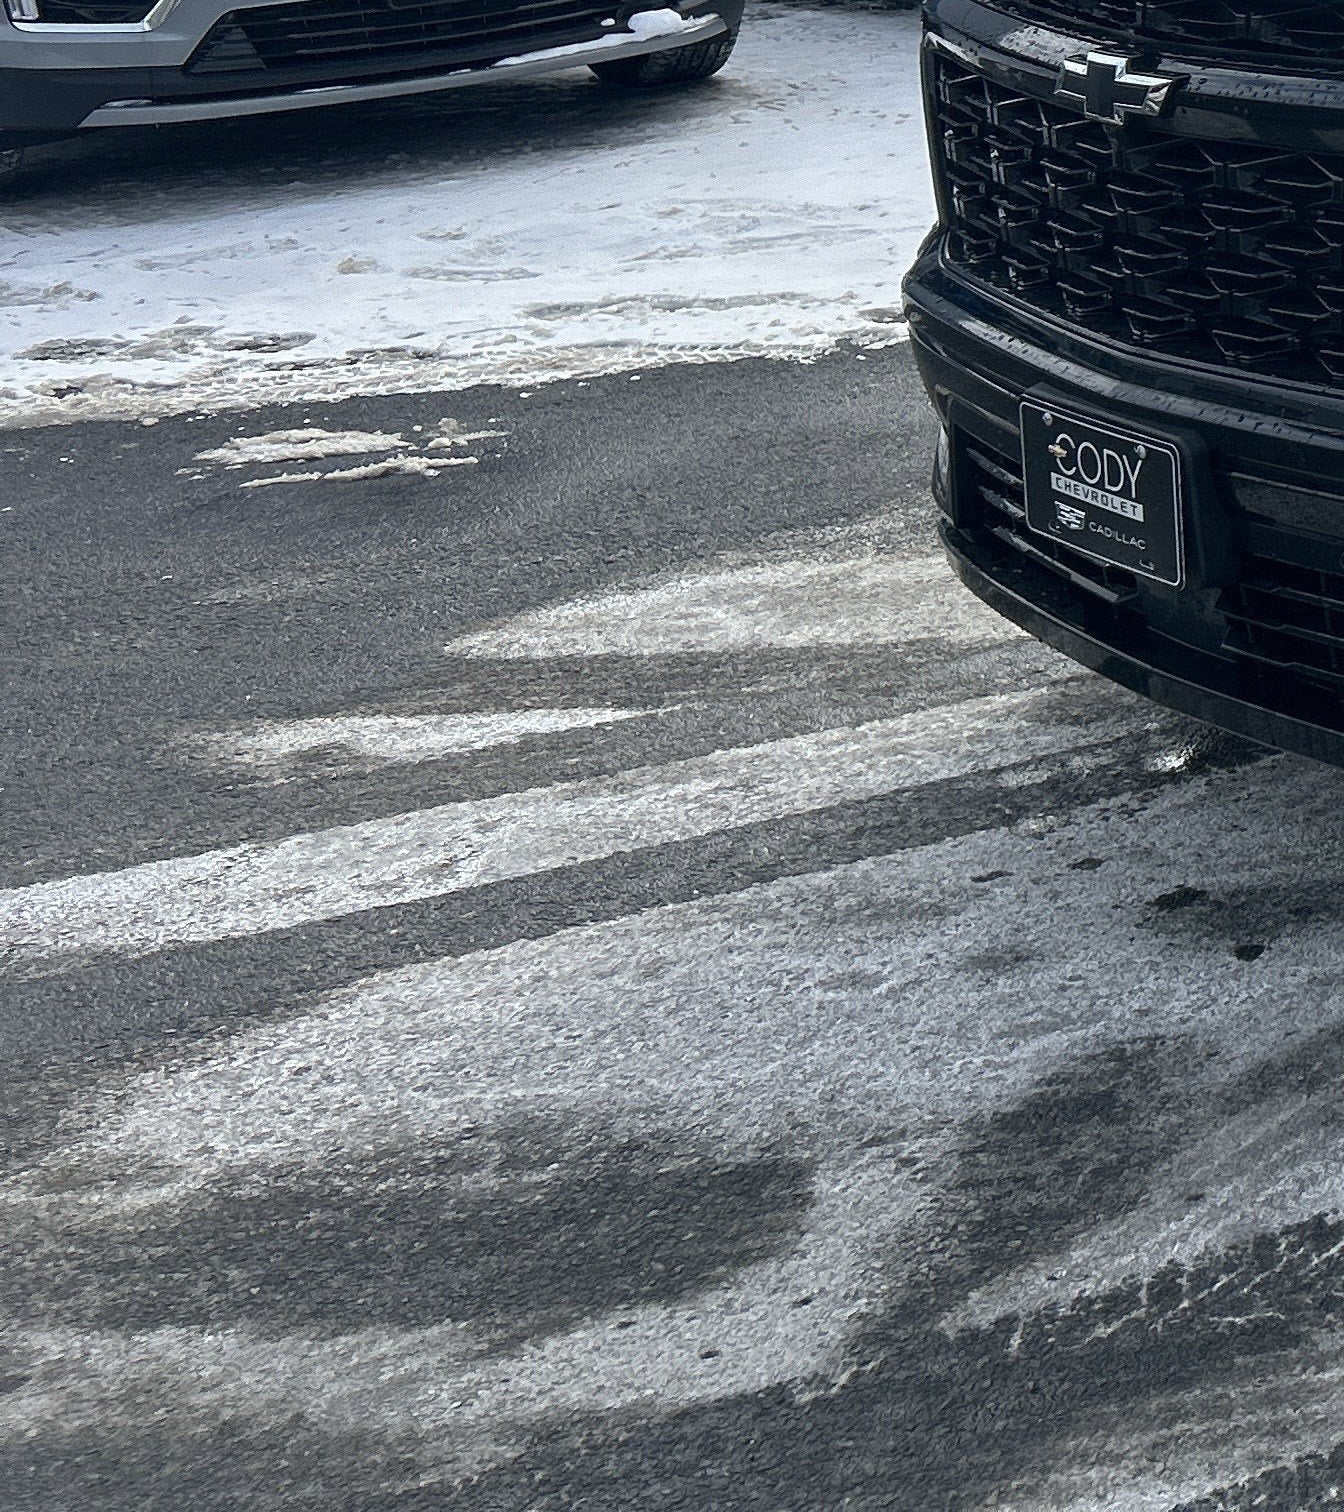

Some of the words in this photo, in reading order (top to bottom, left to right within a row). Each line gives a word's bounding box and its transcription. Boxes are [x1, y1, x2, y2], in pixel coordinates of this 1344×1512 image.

[1053, 433, 1142, 498] CODY
[1055, 476, 1138, 517] CHEVROLET
[1088, 521, 1146, 550] CADILLAC
